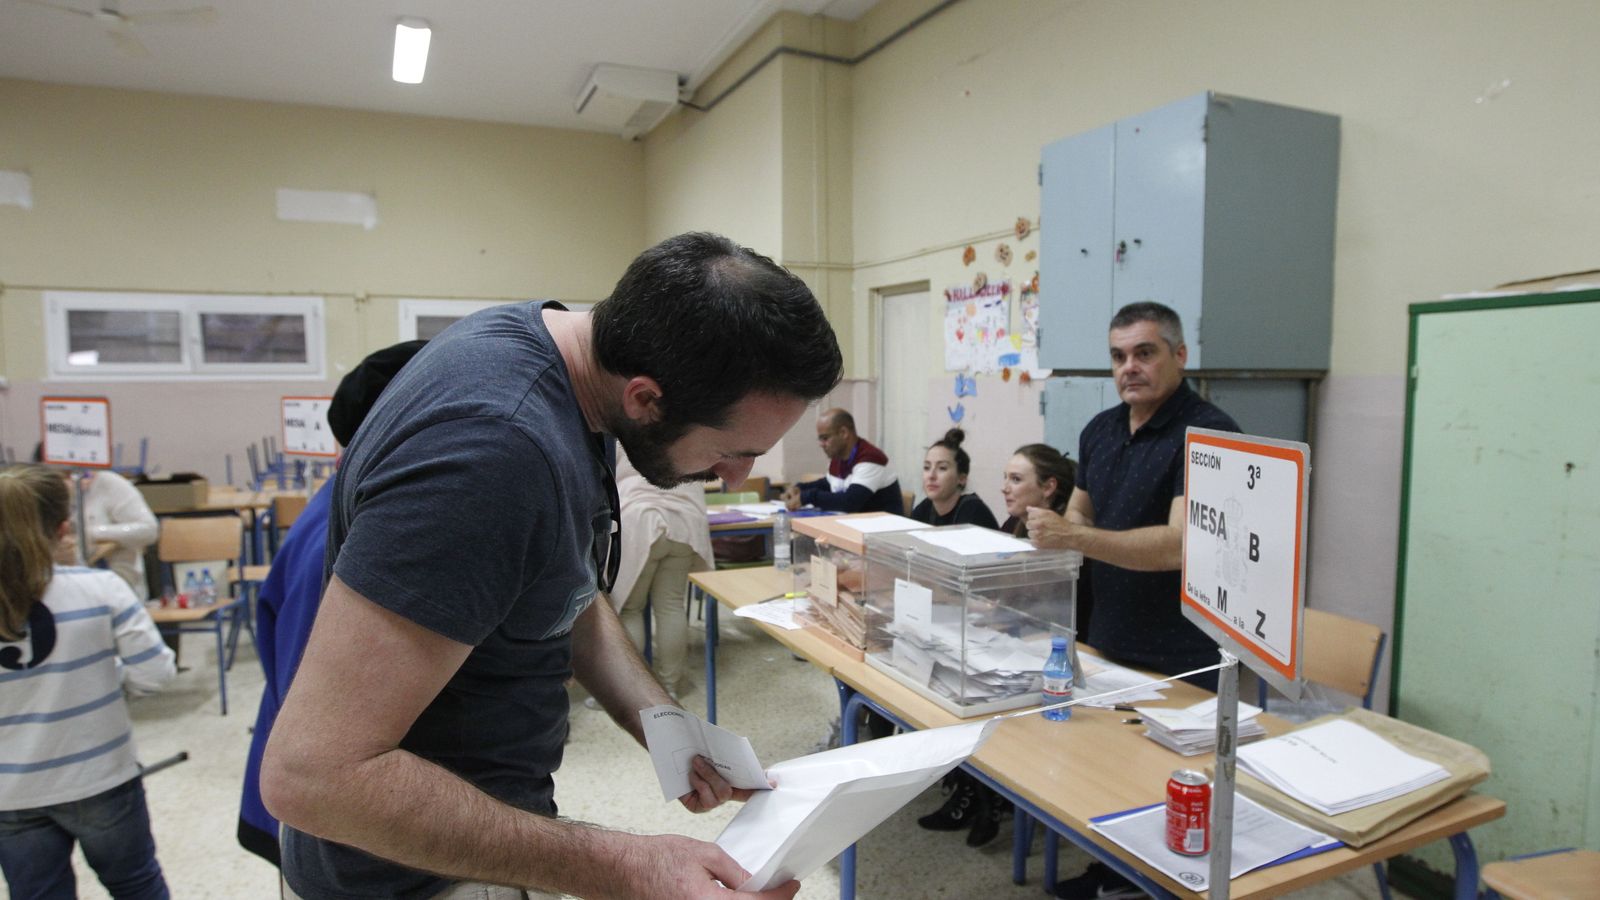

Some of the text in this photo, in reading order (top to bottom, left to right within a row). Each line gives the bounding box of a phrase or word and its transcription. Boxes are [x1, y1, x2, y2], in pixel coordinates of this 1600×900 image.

[1191, 451, 1221, 470] SECCIÓN
[1190, 499, 1260, 563] MESA B
[1217, 585, 1228, 614] M
[1255, 609, 1266, 640] Z
